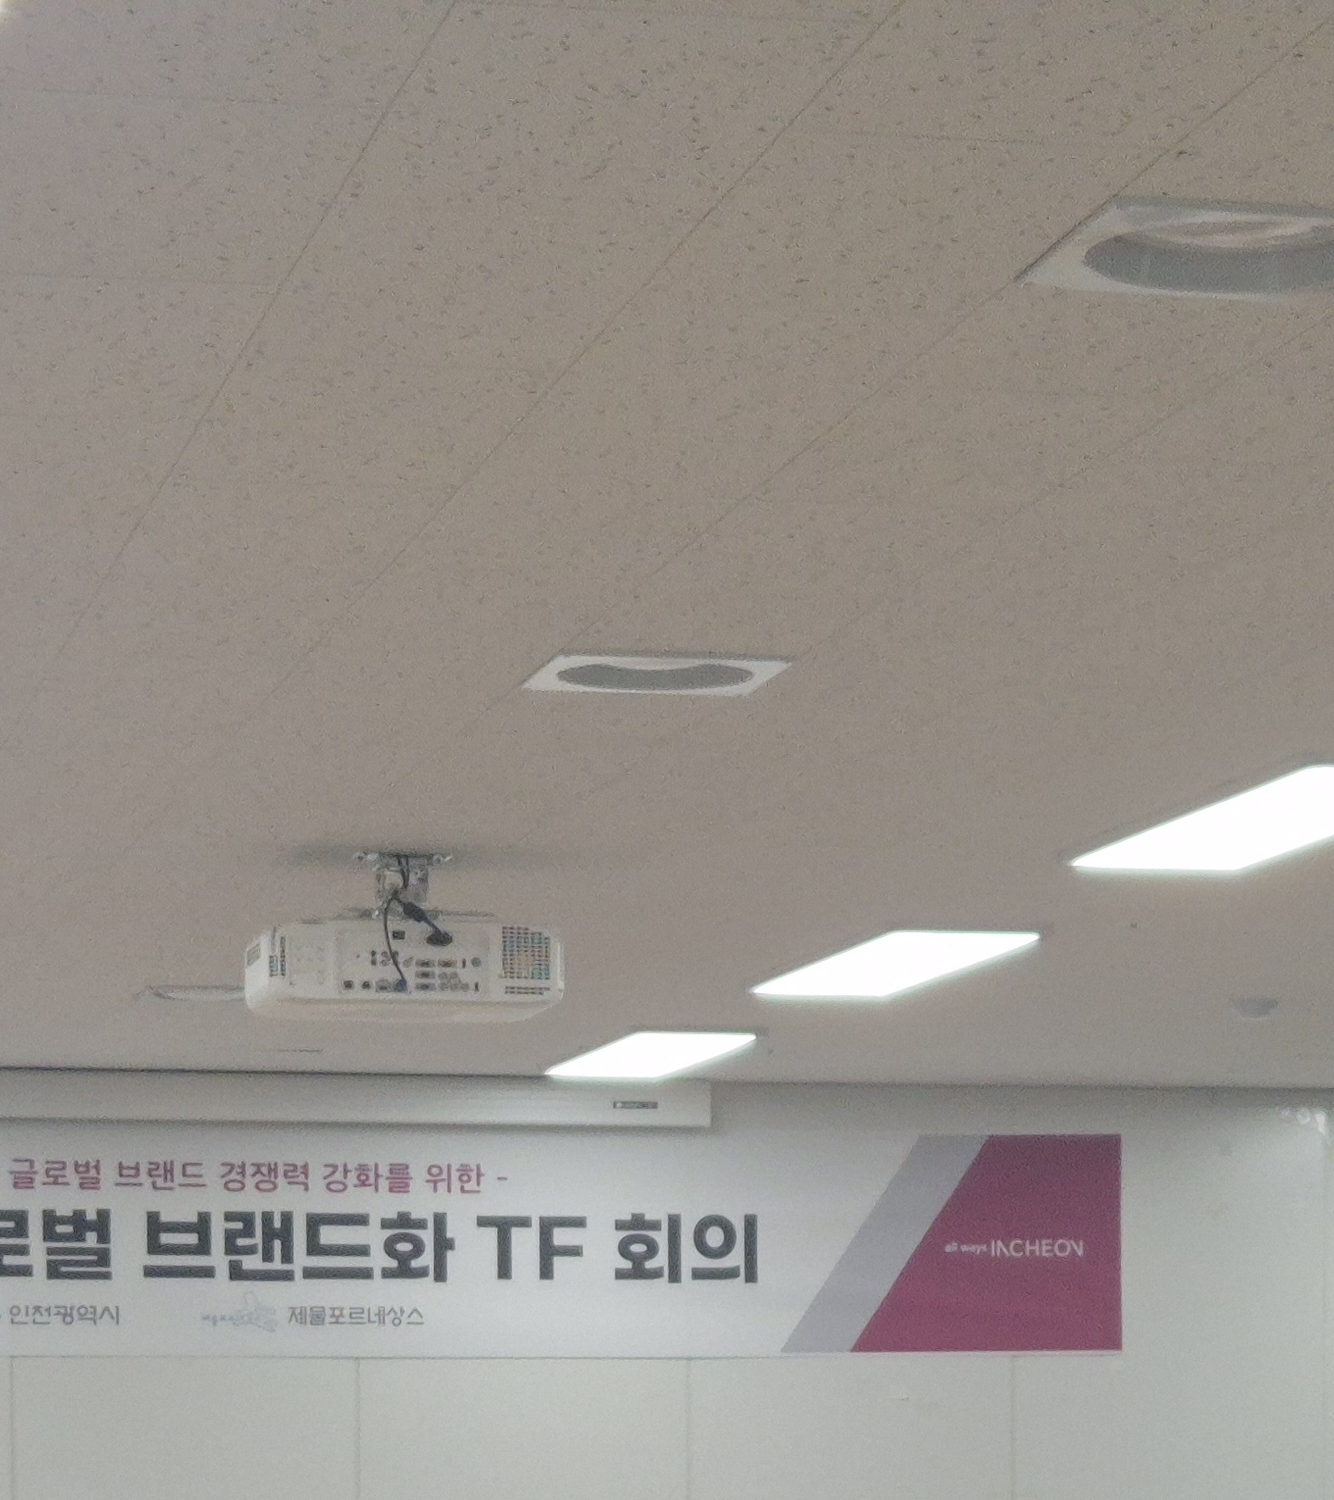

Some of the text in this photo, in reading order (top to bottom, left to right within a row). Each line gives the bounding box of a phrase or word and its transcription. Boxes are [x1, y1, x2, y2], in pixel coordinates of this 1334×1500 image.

[7, 1157, 103, 1192] 글로벌
[114, 1159, 208, 1192] 브랜드
[219, 1160, 310, 1193] 경쟁력
[323, 1162, 412, 1195] 강화를
[425, 1164, 485, 1195] 위한
[142, 1210, 456, 1283] 브랜드화
[476, 1216, 587, 1281] TF
[614, 1213, 758, 1285] 회의
[990, 1239, 1084, 1258] INCHEON
[9, 1304, 121, 1327] 인천광역시
[287, 1305, 425, 1328] 제물포르네상스
